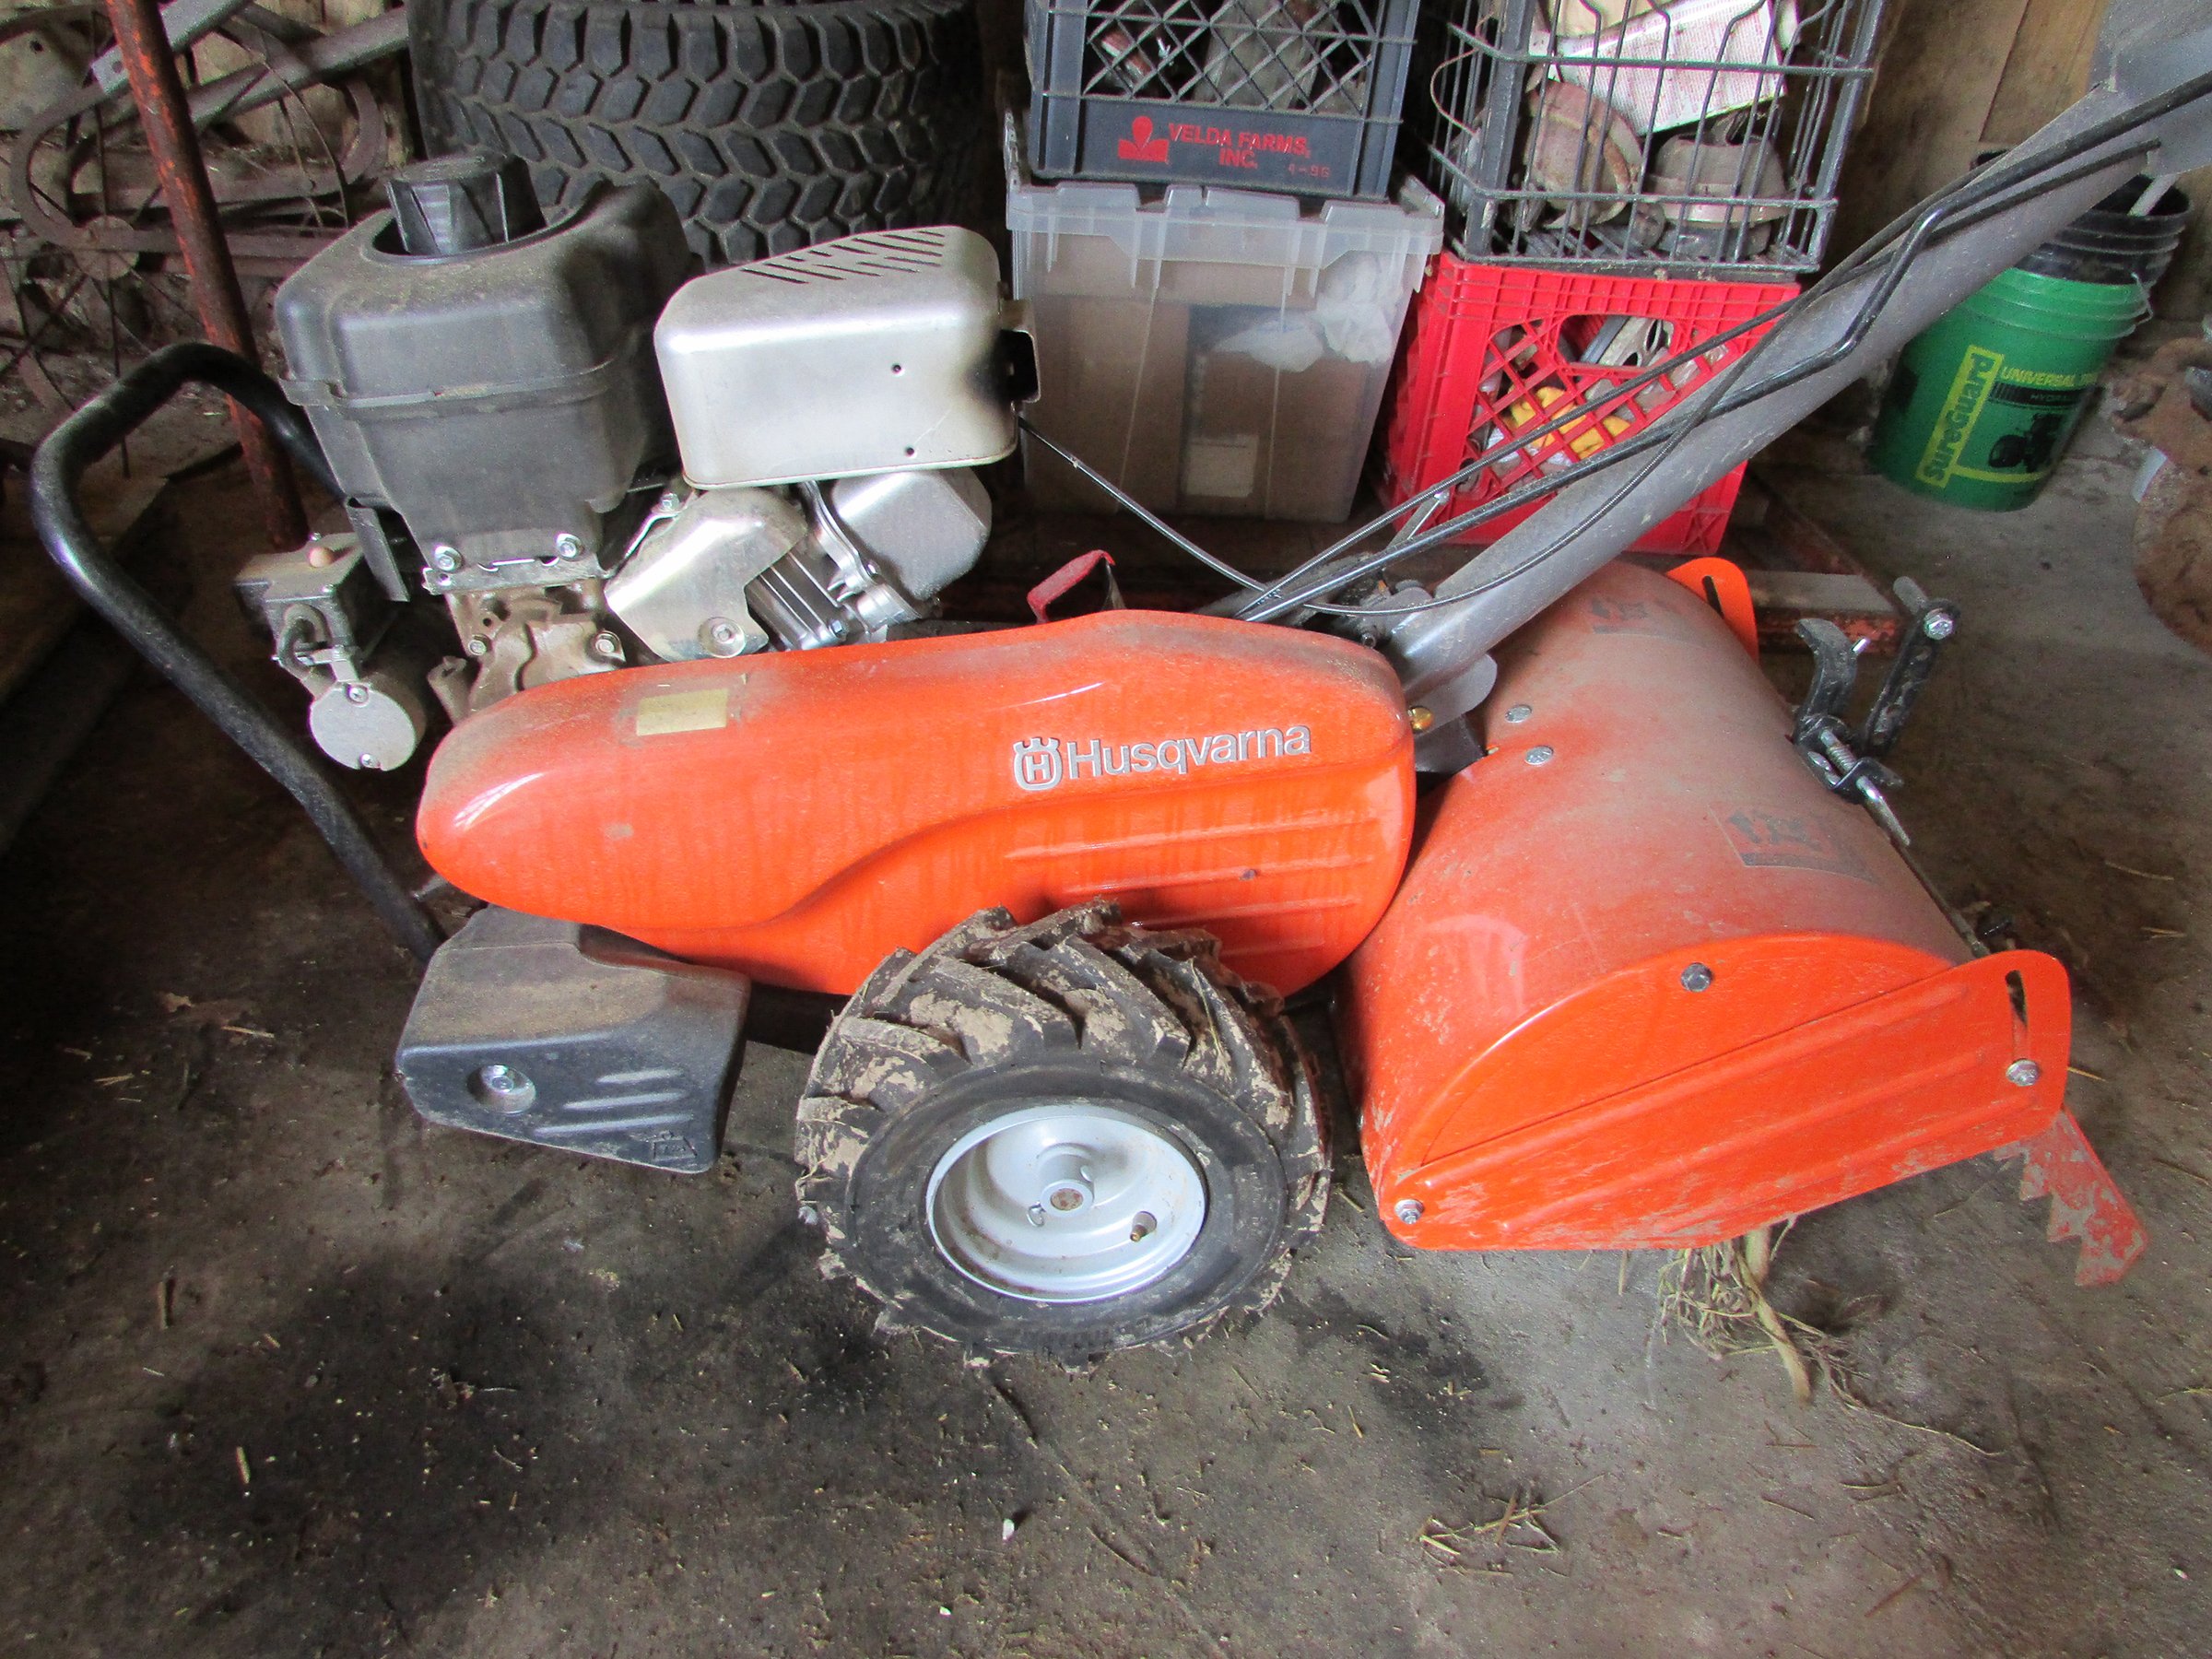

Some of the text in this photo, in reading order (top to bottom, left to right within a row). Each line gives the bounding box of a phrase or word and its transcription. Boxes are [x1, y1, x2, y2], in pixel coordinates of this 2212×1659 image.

[1169, 123, 1232, 147] VELDA
[1219, 147, 1258, 170] INC.
[1066, 724, 1312, 780] Husqvarna
